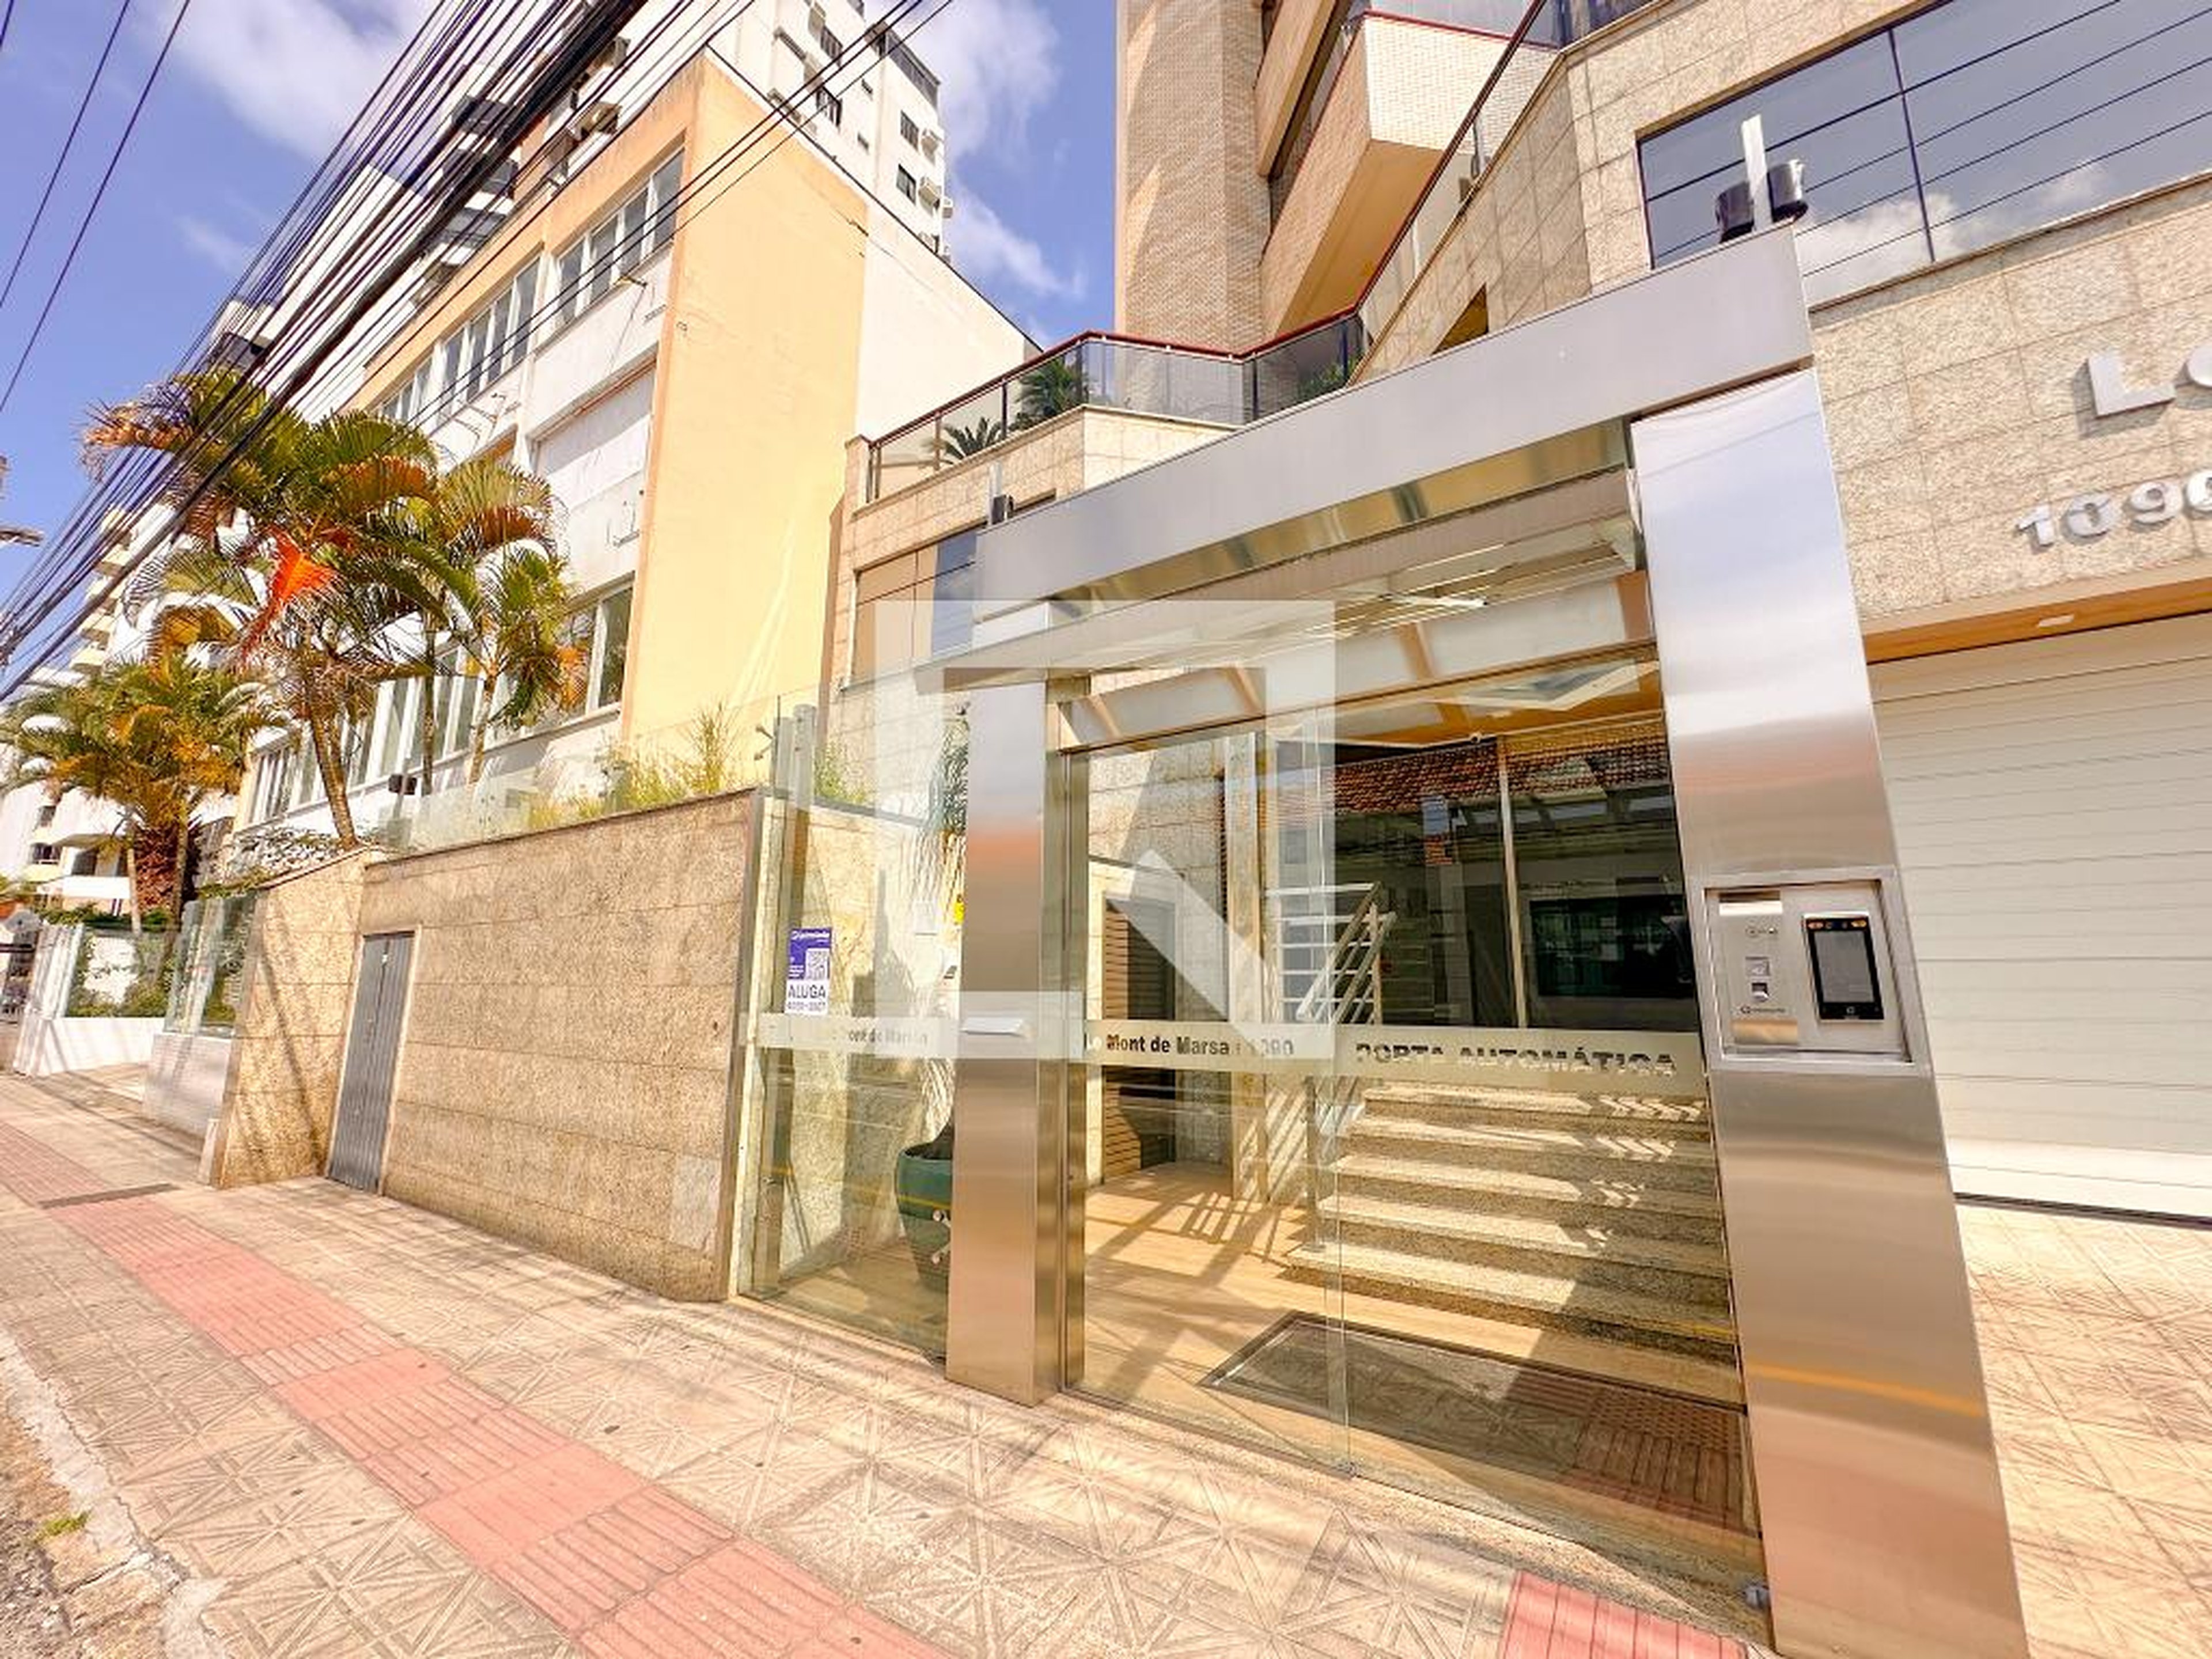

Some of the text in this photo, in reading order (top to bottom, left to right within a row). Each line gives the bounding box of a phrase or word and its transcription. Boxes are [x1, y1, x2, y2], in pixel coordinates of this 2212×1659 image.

[2088, 346, 2212, 418] L
[789, 984, 825, 999] ALUGA
[1106, 1034, 1146, 1052] Mont
[1150, 1036, 1172, 1053] de
[1176, 1036, 1242, 1055] Marsa
[1356, 1043, 1444, 1064] PORTA
